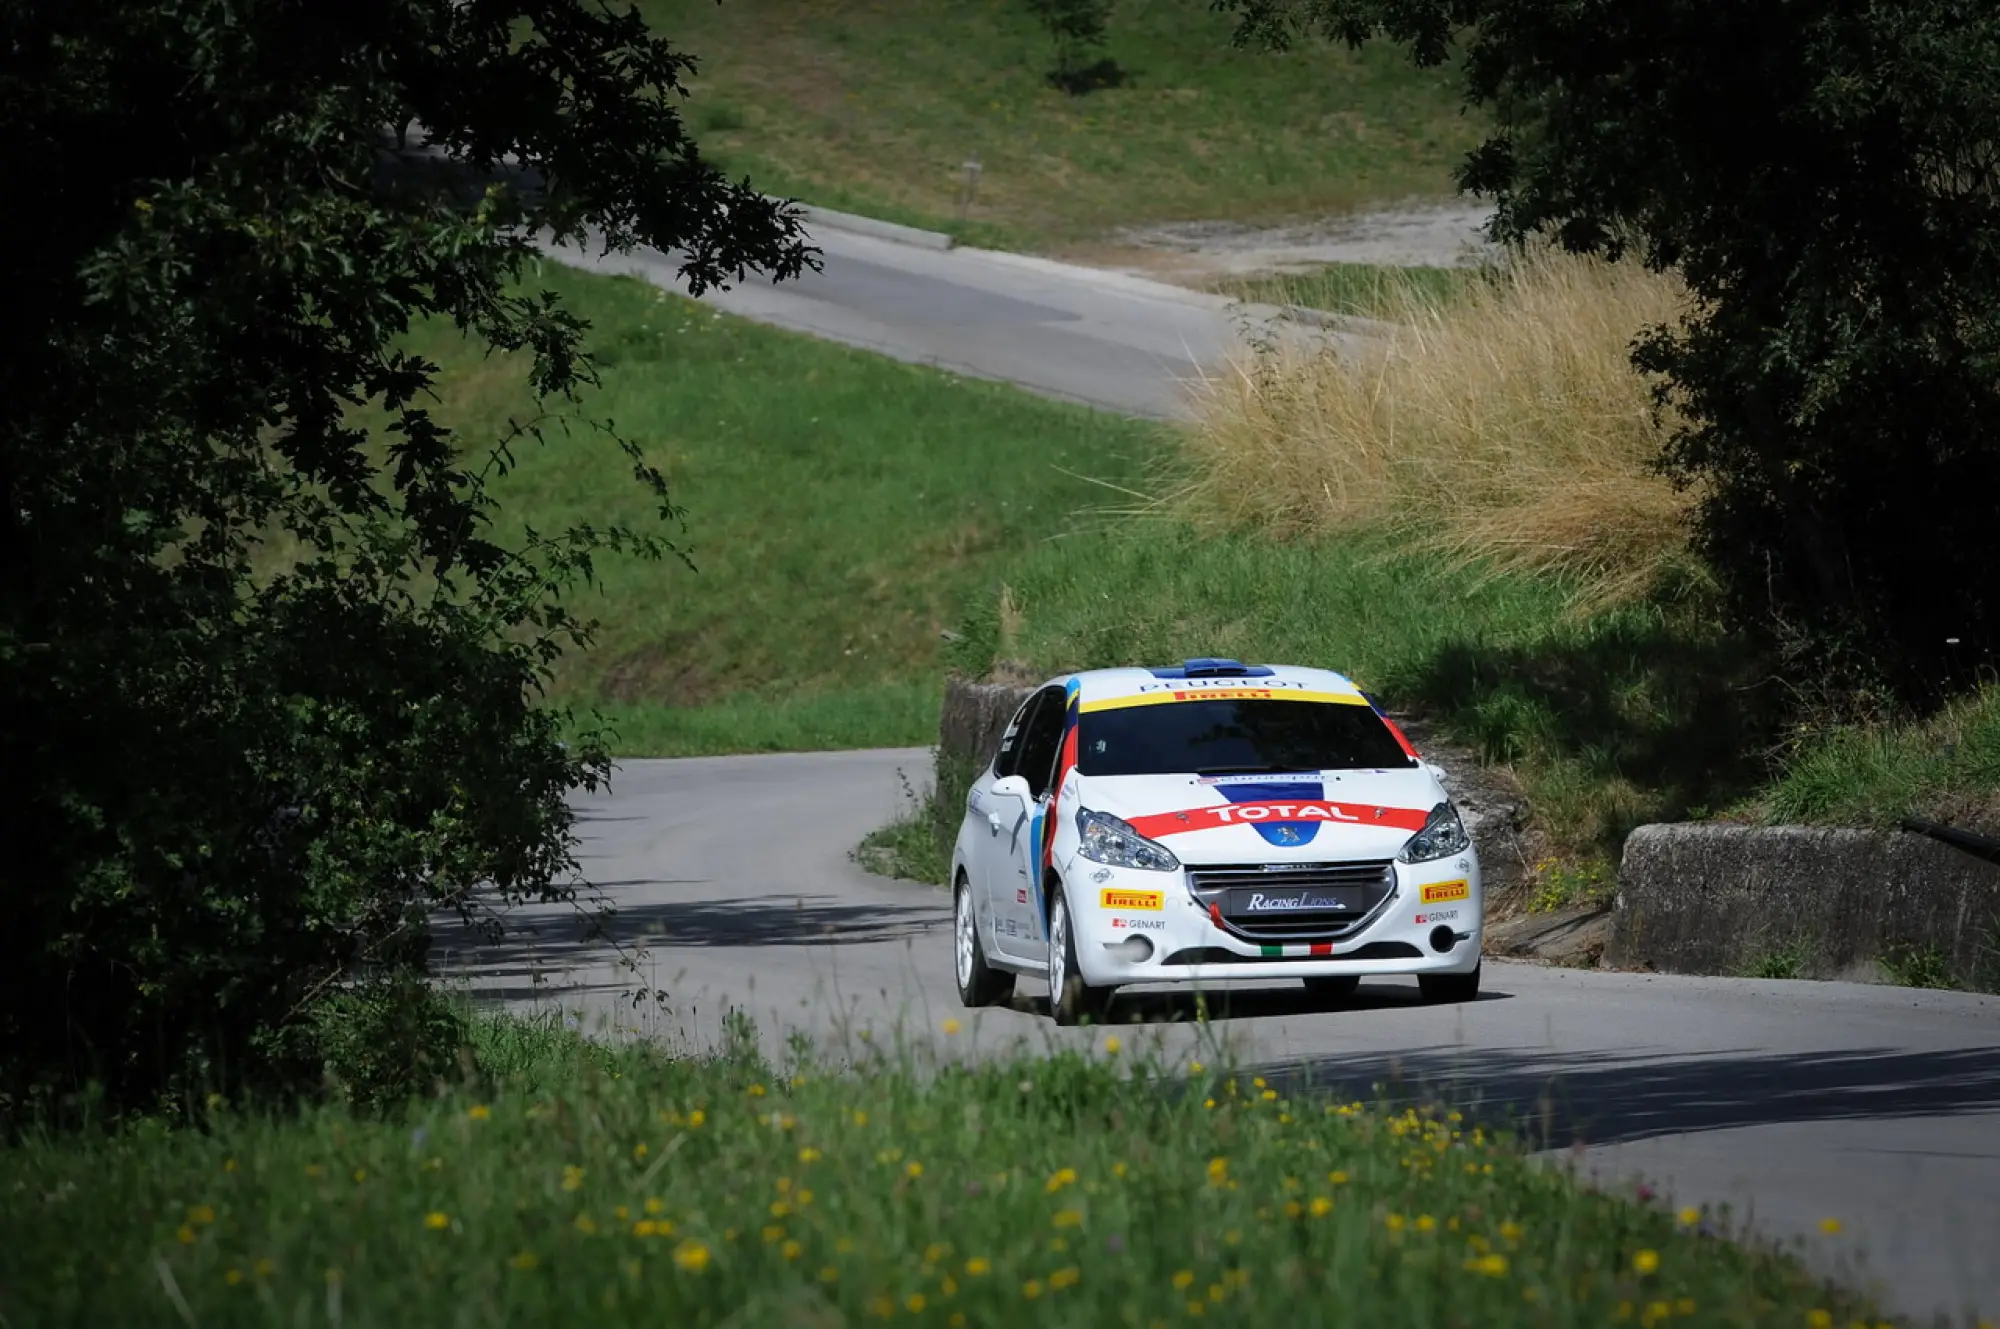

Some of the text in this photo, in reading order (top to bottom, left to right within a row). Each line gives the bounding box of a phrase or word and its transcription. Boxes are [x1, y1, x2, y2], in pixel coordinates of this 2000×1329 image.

[1174, 688, 1271, 701] PIRELLI
[1207, 805, 1359, 822] TOTAL
[1106, 892, 1157, 906] PIRELLI
[1129, 919, 1166, 930] GENART
